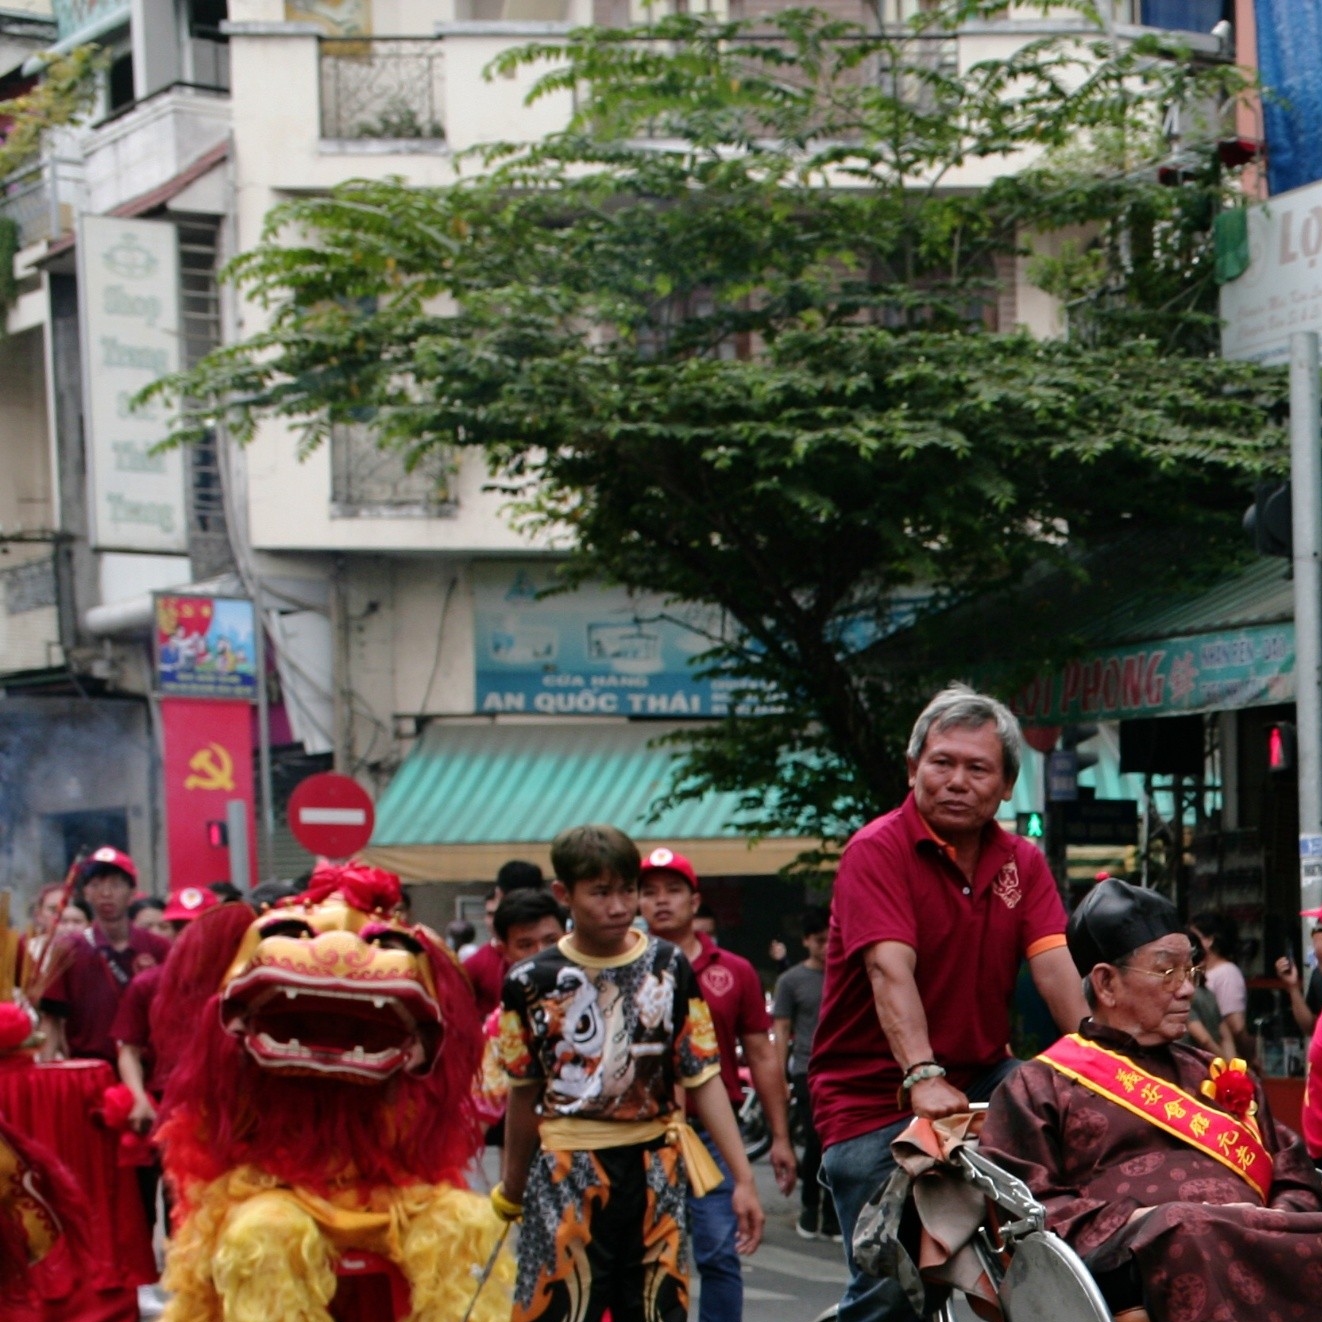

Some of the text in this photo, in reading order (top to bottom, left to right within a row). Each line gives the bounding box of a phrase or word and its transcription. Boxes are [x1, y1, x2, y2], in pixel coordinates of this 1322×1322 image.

[483, 692, 525, 711] AN
[534, 687, 618, 713] QUỐC
[627, 690, 701, 713] THÁI
[1114, 1067, 1256, 1170] 義安會館元老
